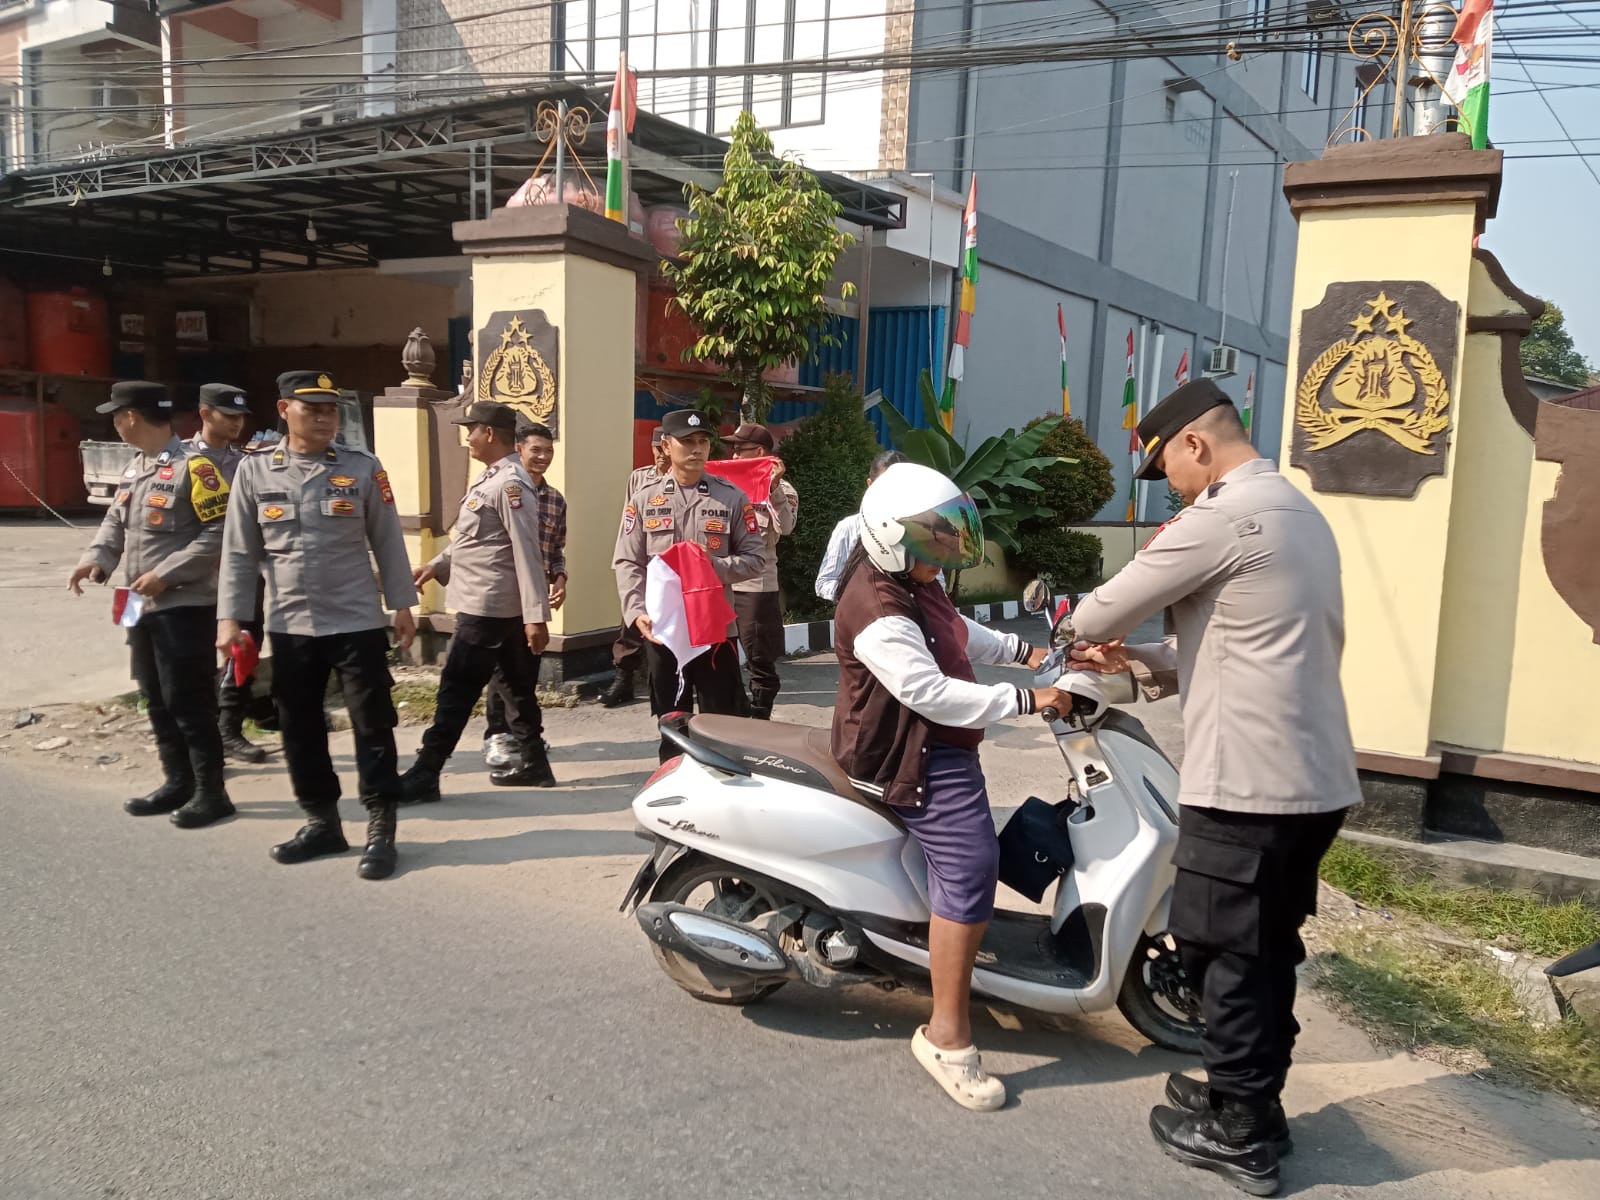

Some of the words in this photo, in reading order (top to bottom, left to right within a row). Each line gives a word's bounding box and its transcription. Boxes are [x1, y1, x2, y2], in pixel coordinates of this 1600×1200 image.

[150, 482, 175, 493] POLRI
[326, 487, 359, 497] POLRI
[701, 508, 729, 518] POLRI
[755, 755, 807, 774] Filano
